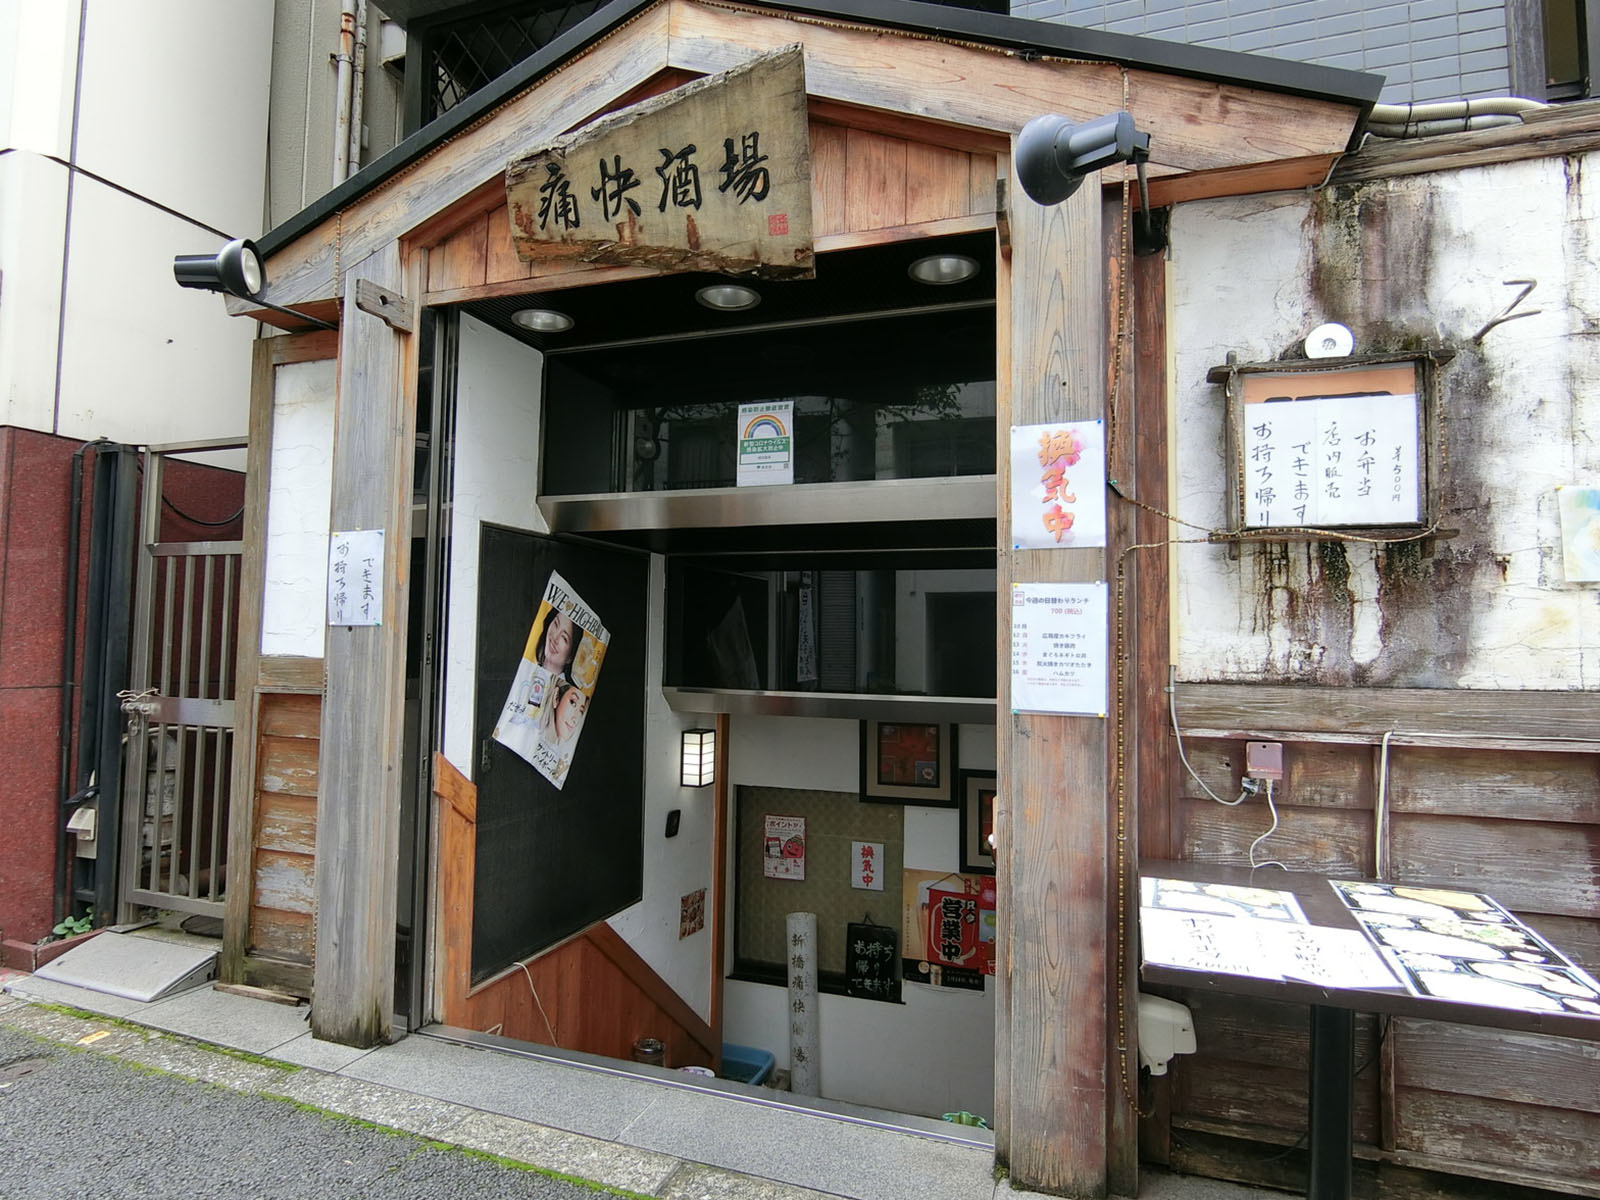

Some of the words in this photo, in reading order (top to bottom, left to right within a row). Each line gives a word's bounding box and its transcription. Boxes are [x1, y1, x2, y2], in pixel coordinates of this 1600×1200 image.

[538, 131, 770, 230] 痛快酒場
[1354, 429, 1376, 497] お弁当
[546, 583, 570, 611] WE
[568, 603, 605, 641] HIGHBALL
[861, 844, 875, 887] 換気中
[941, 896, 962, 961] 営業中
